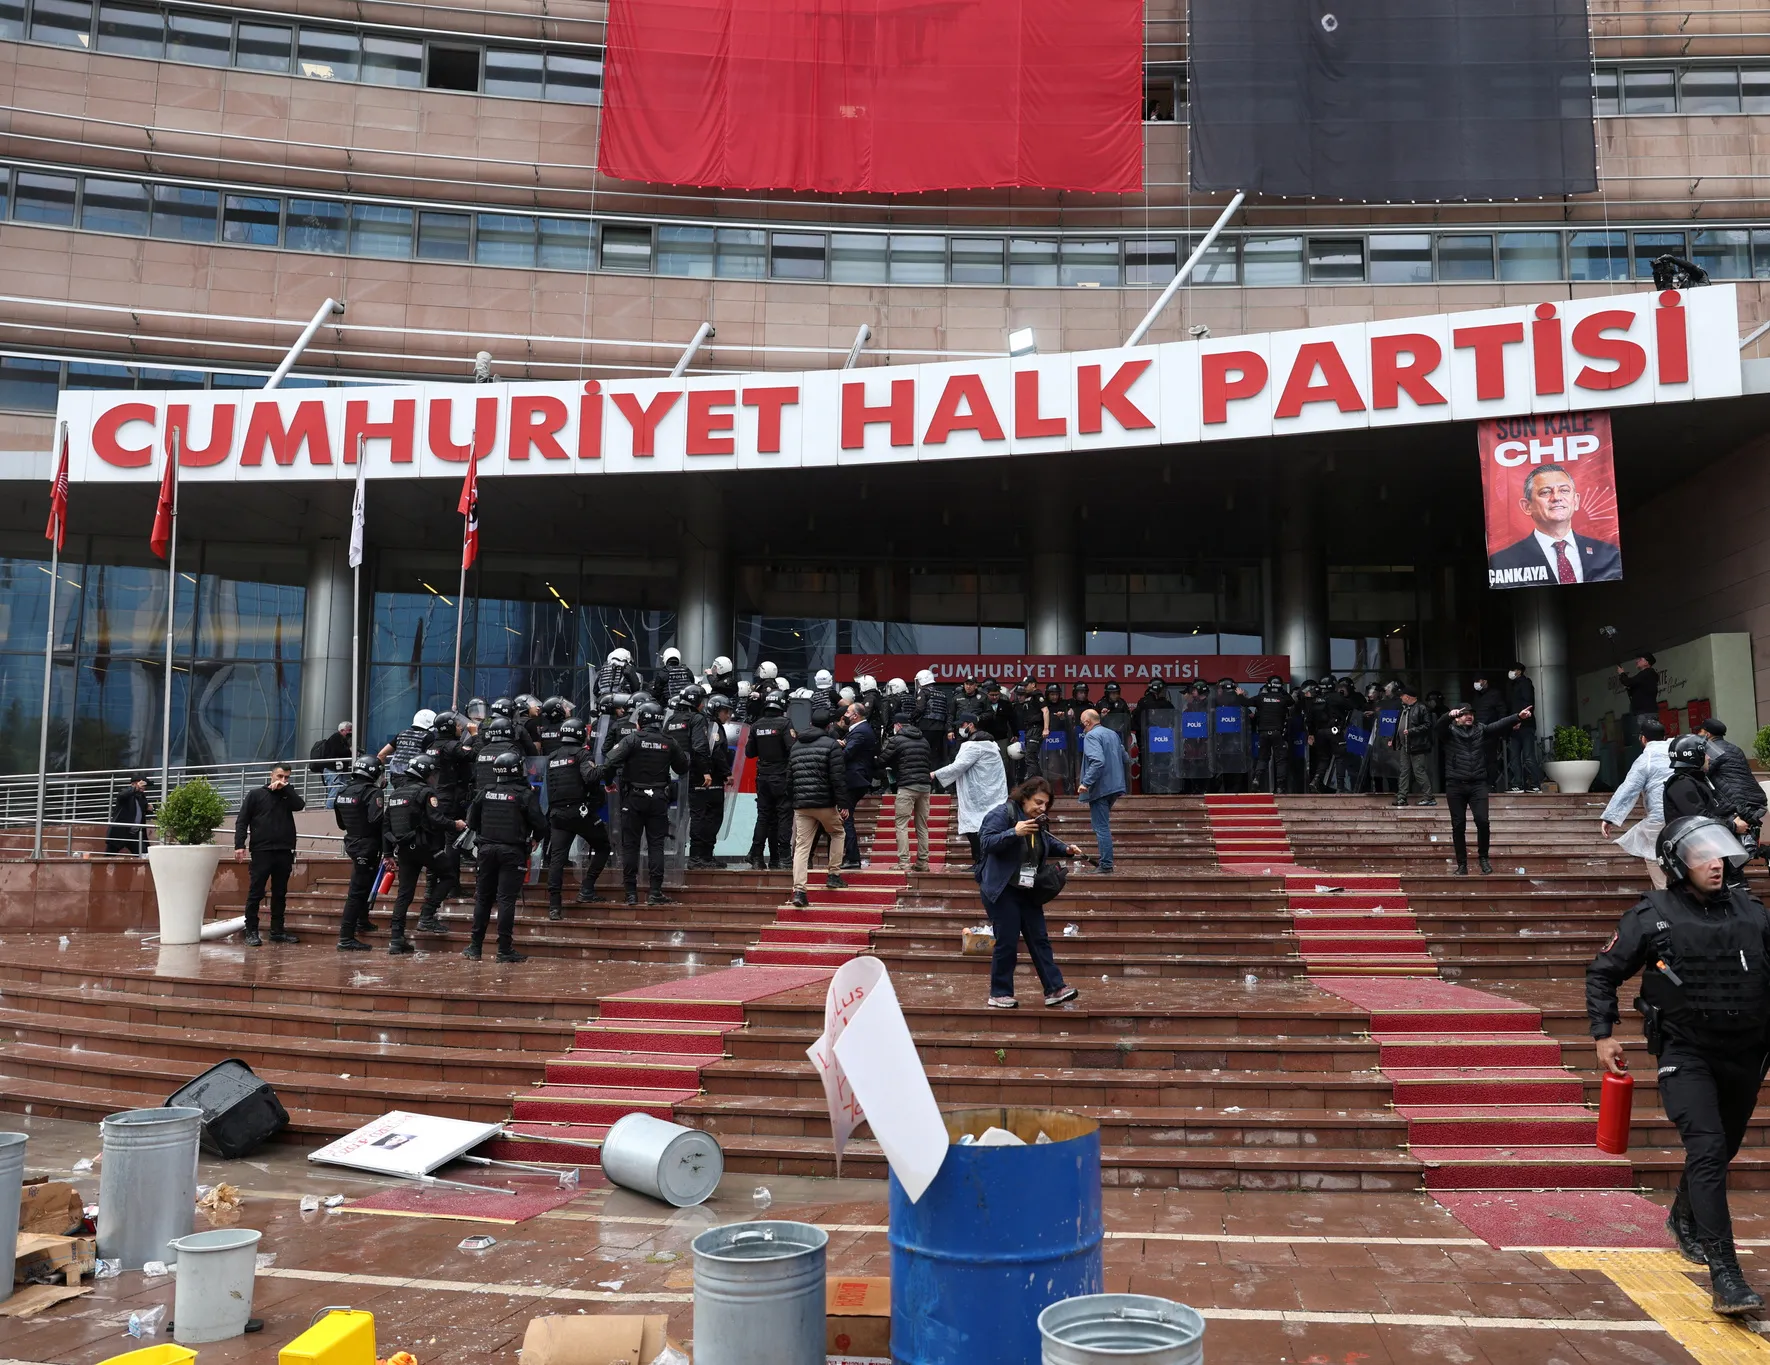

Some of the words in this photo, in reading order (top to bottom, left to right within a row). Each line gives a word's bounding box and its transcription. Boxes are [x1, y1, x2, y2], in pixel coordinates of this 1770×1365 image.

[92, 380, 799, 467] CUMHURİYET
[841, 359, 1156, 450] HALK
[1202, 289, 1689, 425] PARTİSİ
[1496, 416, 1536, 440] SON
[1544, 411, 1594, 435] KALE
[1494, 434, 1600, 467] CHP
[1489, 565, 1549, 587] ÇANKAYA
[929, 660, 1057, 678] CUMHURİYET
[1064, 664, 1116, 678] HALK
[1124, 660, 1199, 678] PARTİSİ
[1348, 733, 1364, 743] POLİS
